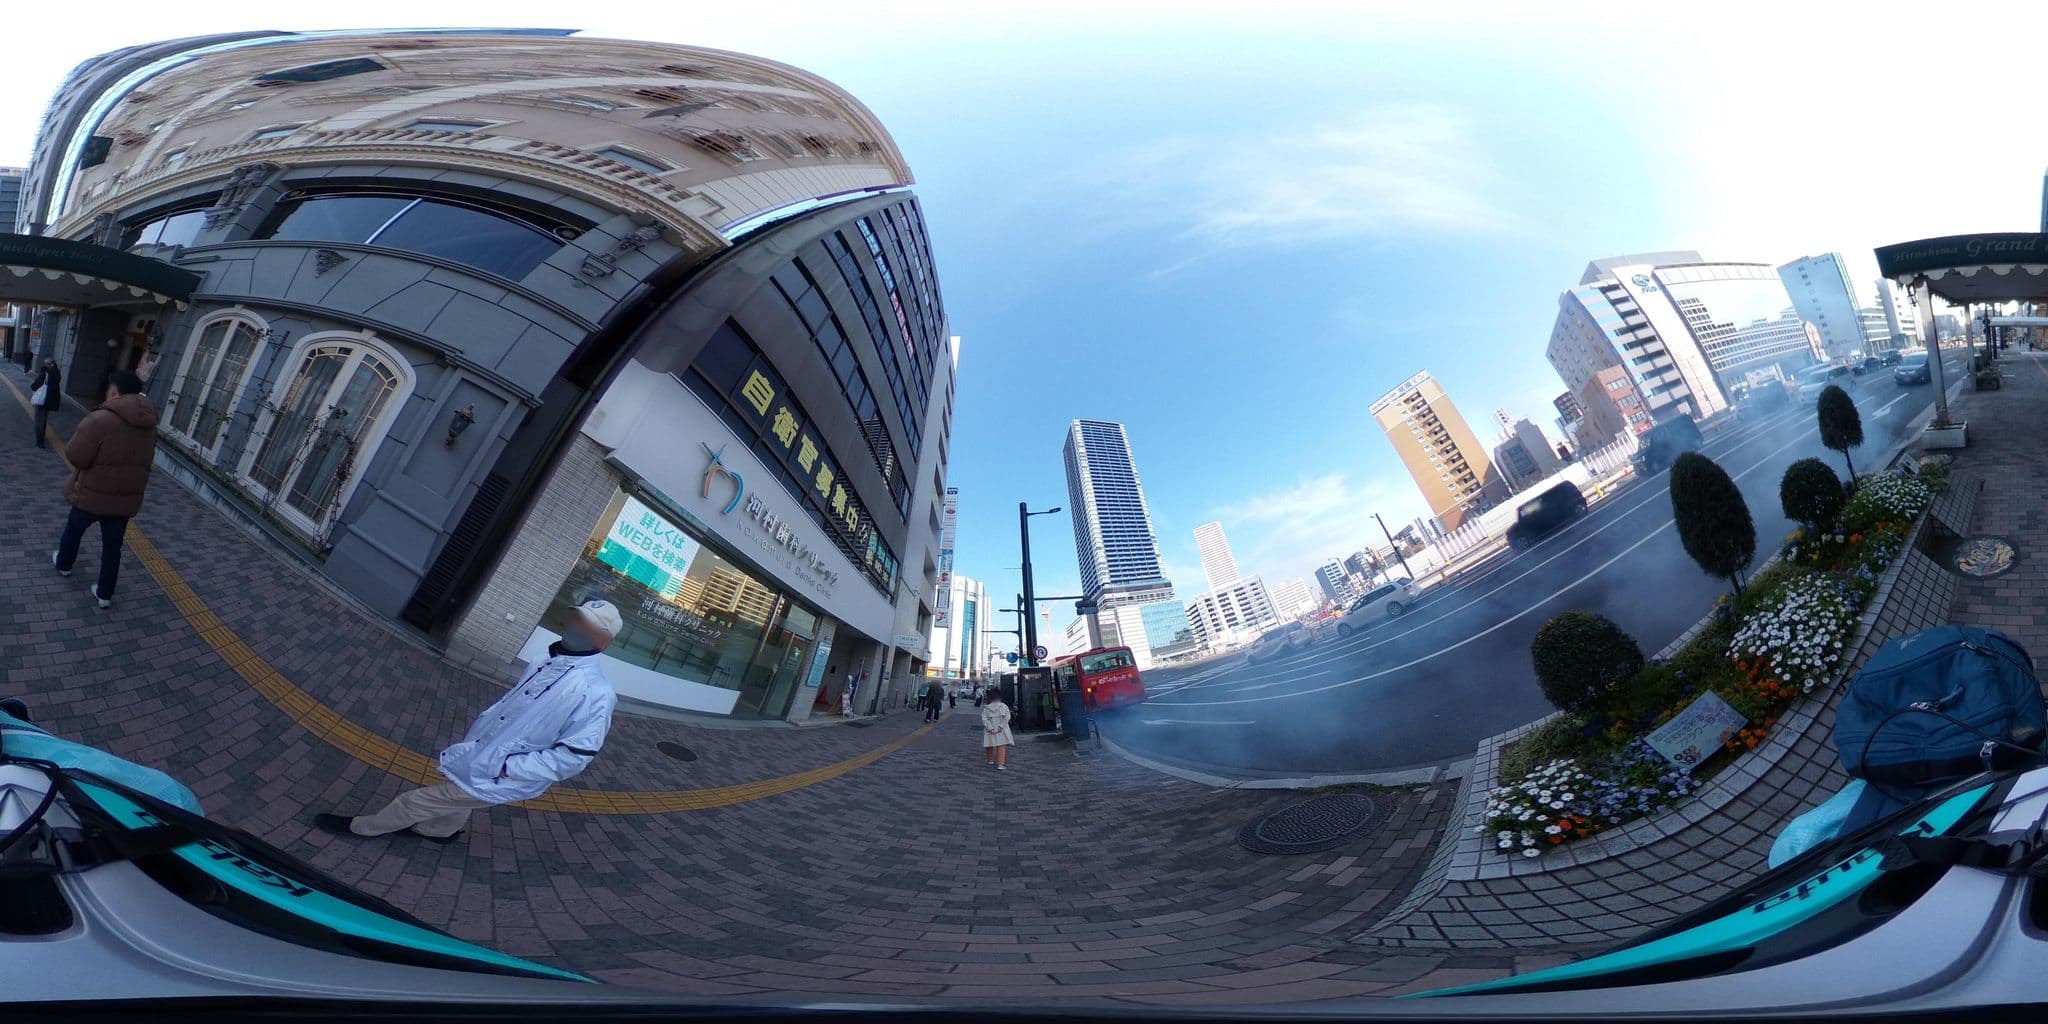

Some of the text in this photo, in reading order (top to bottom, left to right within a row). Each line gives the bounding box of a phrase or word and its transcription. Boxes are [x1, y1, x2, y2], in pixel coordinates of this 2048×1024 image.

[0, 243, 65, 257] ntelligent
[1895, 238, 2038, 263] Hiroshima Grand
[618, 521, 686, 571] WEBを検索
[640, 512, 685, 549] 詳しくは
[745, 493, 838, 585] 河村歯科クリニック
